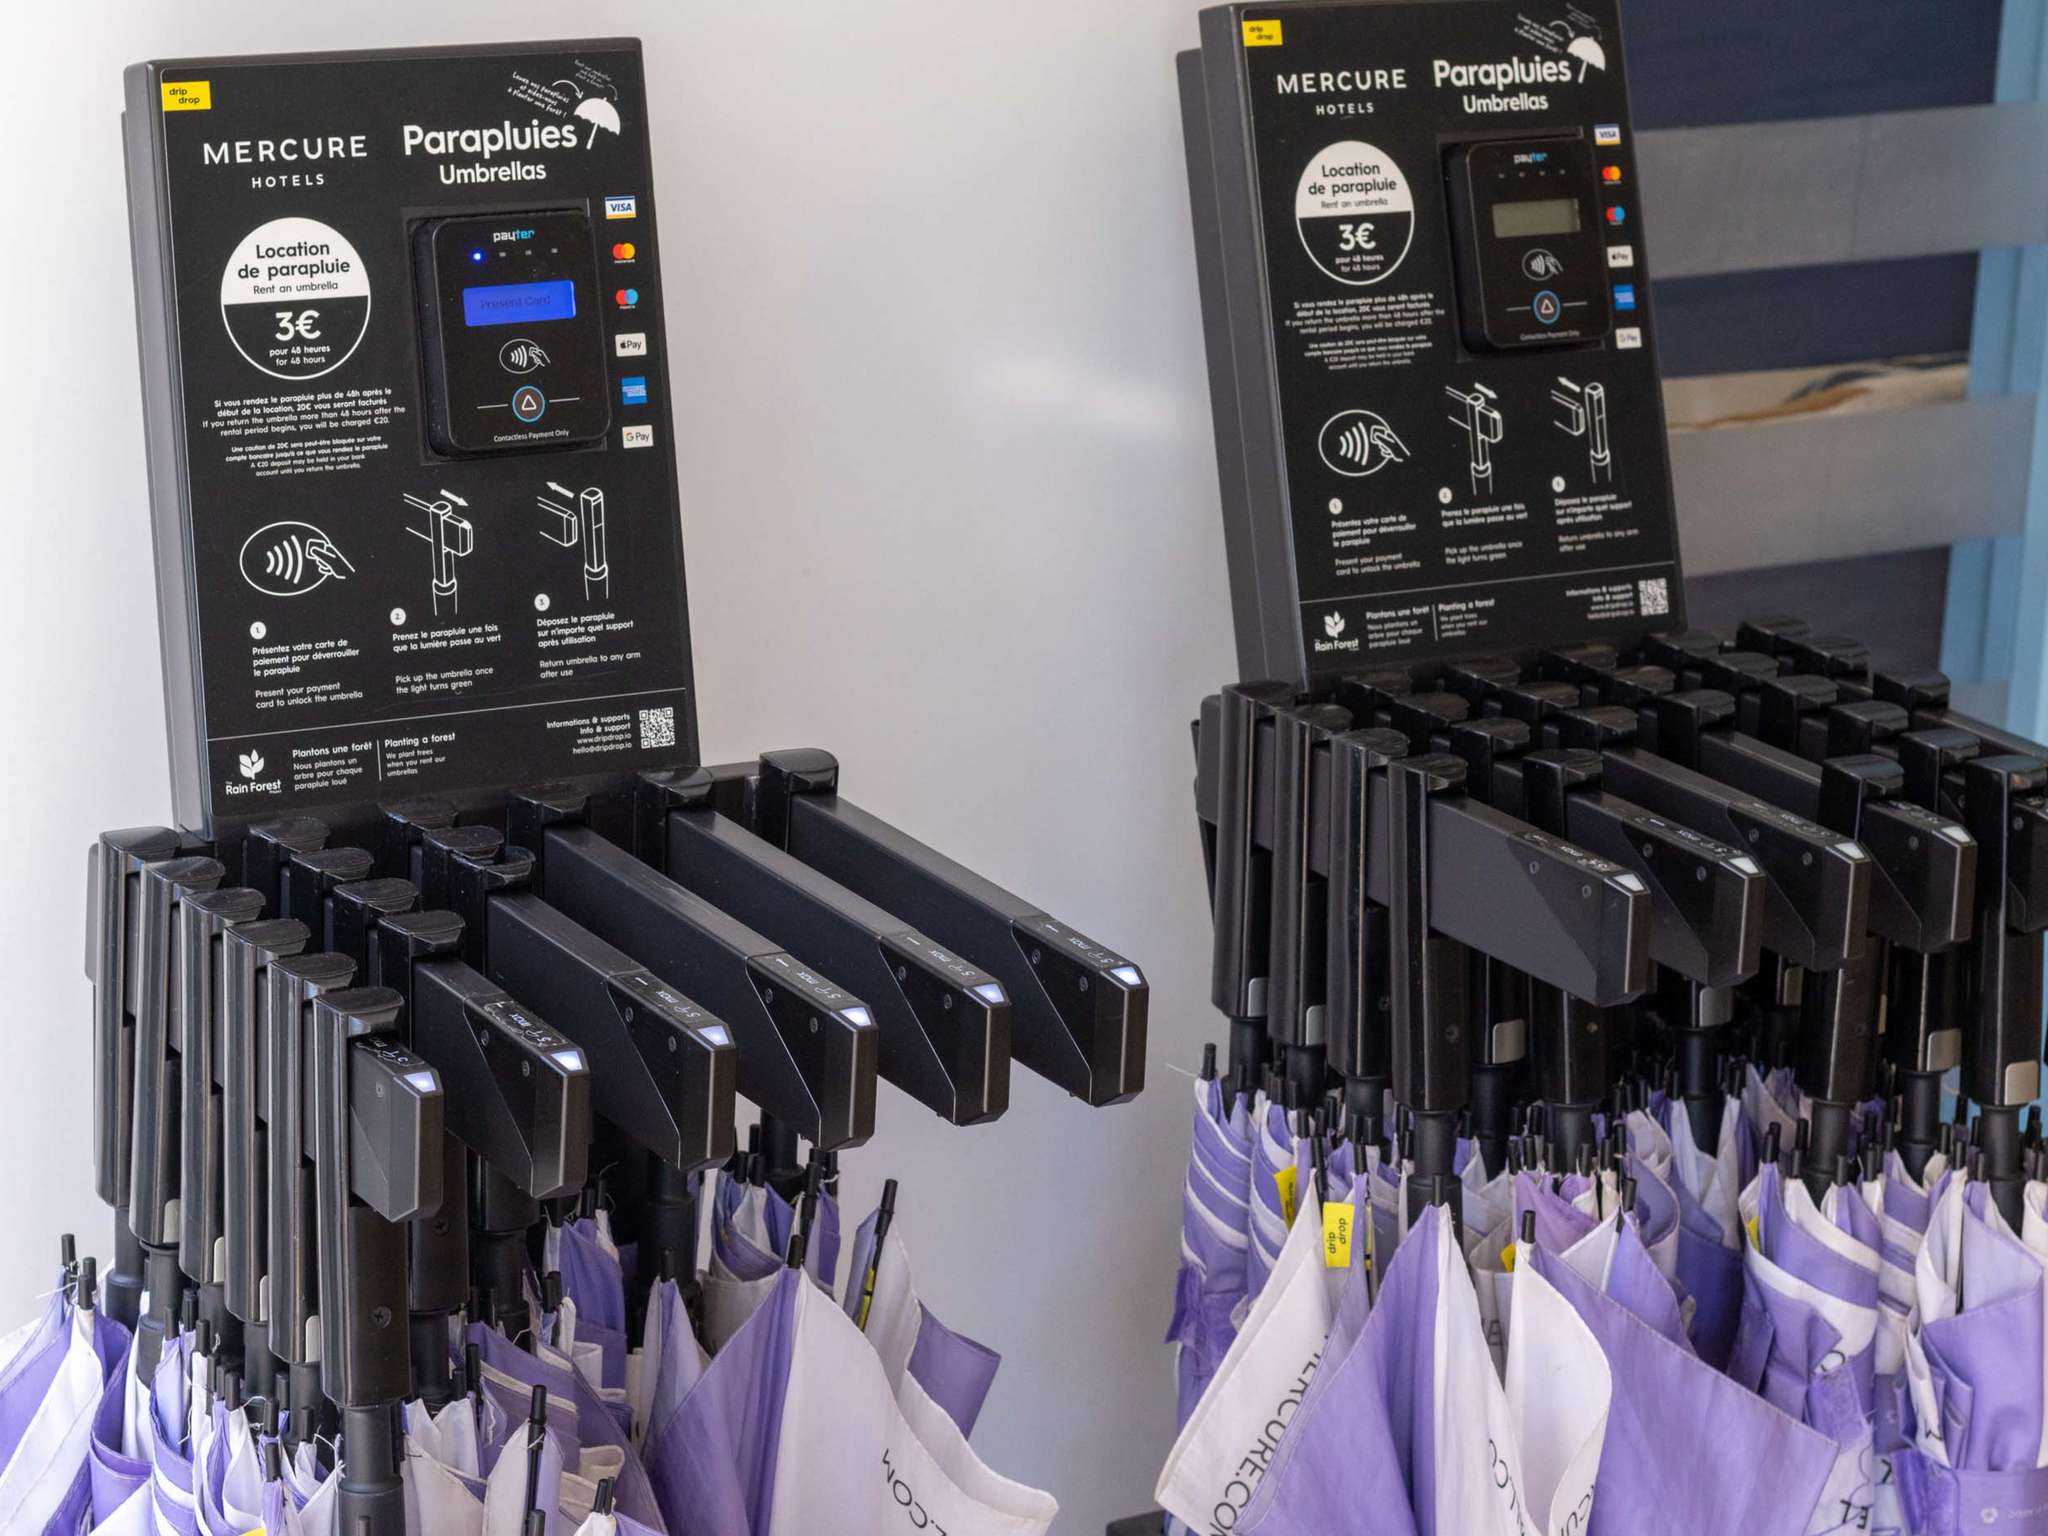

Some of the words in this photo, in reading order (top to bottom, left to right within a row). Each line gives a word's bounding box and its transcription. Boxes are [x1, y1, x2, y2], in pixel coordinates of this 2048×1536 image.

[1433, 55, 1572, 91] Parapluies
[1277, 68, 1407, 94] MERCURE
[169, 87, 187, 96] drip
[178, 96, 200, 105] drop
[1463, 92, 1548, 113] Umbrellas
[1316, 102, 1374, 115] HOTELS
[403, 119, 577, 159] Parapluies
[203, 135, 367, 165] MERCURE
[1513, 152, 1548, 164] payter
[439, 161, 546, 185] Umbrellas
[1322, 163, 1381, 178] Location
[252, 173, 325, 188] HOTELS
[1308, 182, 1325, 195] de
[1332, 178, 1397, 196] parapluie
[610, 203, 632, 212] VISA
[493, 229, 535, 243] payter
[1339, 223, 1376, 251] 3€
[256, 242, 330, 259] Location
[238, 264, 260, 279] de
[268, 258, 350, 280] parapluie
[254, 285, 275, 294] Rent
[280, 285, 292, 293] an
[296, 281, 338, 292] umbrella
[275, 310, 321, 341] 3€
[270, 348, 288, 357] pour
[291, 346, 300, 355] 48
[304, 345, 330, 354] heures
[627, 341, 641, 350] Pay
[276, 357, 287, 366] for
[304, 355, 325, 363] hours
[243, 397, 268, 405] rendez
[280, 394, 314, 403] parapluie
[363, 389, 382, 397] après
[203, 420, 208, 428] If
[210, 420, 224, 428] you
[494, 433, 527, 442] Contactless
[529, 430, 554, 439] Payment
[555, 429, 569, 437] Only
[626, 432, 634, 441] G
[636, 432, 649, 441] Pay
[537, 618, 568, 626] Déposez
[581, 612, 615, 623] parapluie
[392, 633, 418, 641] Prenez
[431, 627, 465, 639] parapluie
[485, 624, 498, 632] fois
[252, 645, 289, 655] Présentez
[293, 643, 312, 651] votre
[315, 641, 335, 649] carte
[393, 644, 408, 652] que
[410, 642, 417, 650] la
[420, 639, 447, 649] lumière
[450, 638, 471, 648] passe
[486, 634, 501, 642] vert
[1315, 641, 1333, 651] Rain
[1334, 638, 1359, 649] Forest
[253, 656, 289, 667] paiement
[292, 654, 309, 662] pour
[312, 649, 359, 659] déverrouiller
[540, 659, 564, 668] Return
[566, 655, 597, 665] umbrella
[610, 653, 623, 661] any
[264, 665, 300, 677] parapluie
[395, 675, 411, 683] Pick
[414, 674, 423, 682] up
[426, 672, 437, 680] the
[441, 668, 472, 678] umbrella
[540, 670, 557, 678] after
[256, 688, 283, 698] Present
[287, 686, 303, 696] your
[307, 682, 340, 694] payment
[396, 686, 408, 694] the
[411, 684, 426, 694] light
[430, 682, 448, 690] turns
[451, 680, 472, 690] green
[256, 701, 273, 709] card
[288, 696, 312, 705] unlock
[315, 694, 327, 702] the
[330, 691, 363, 700] umbrella
[385, 738, 419, 748] Planting
[432, 732, 455, 742] forest
[292, 748, 329, 758] Plantons
[352, 741, 372, 752] forêt
[226, 784, 248, 795] Rain
[250, 779, 281, 792] Forest
[1339, 1218, 1348, 1244] drop
[1327, 1232, 1336, 1254] drip
